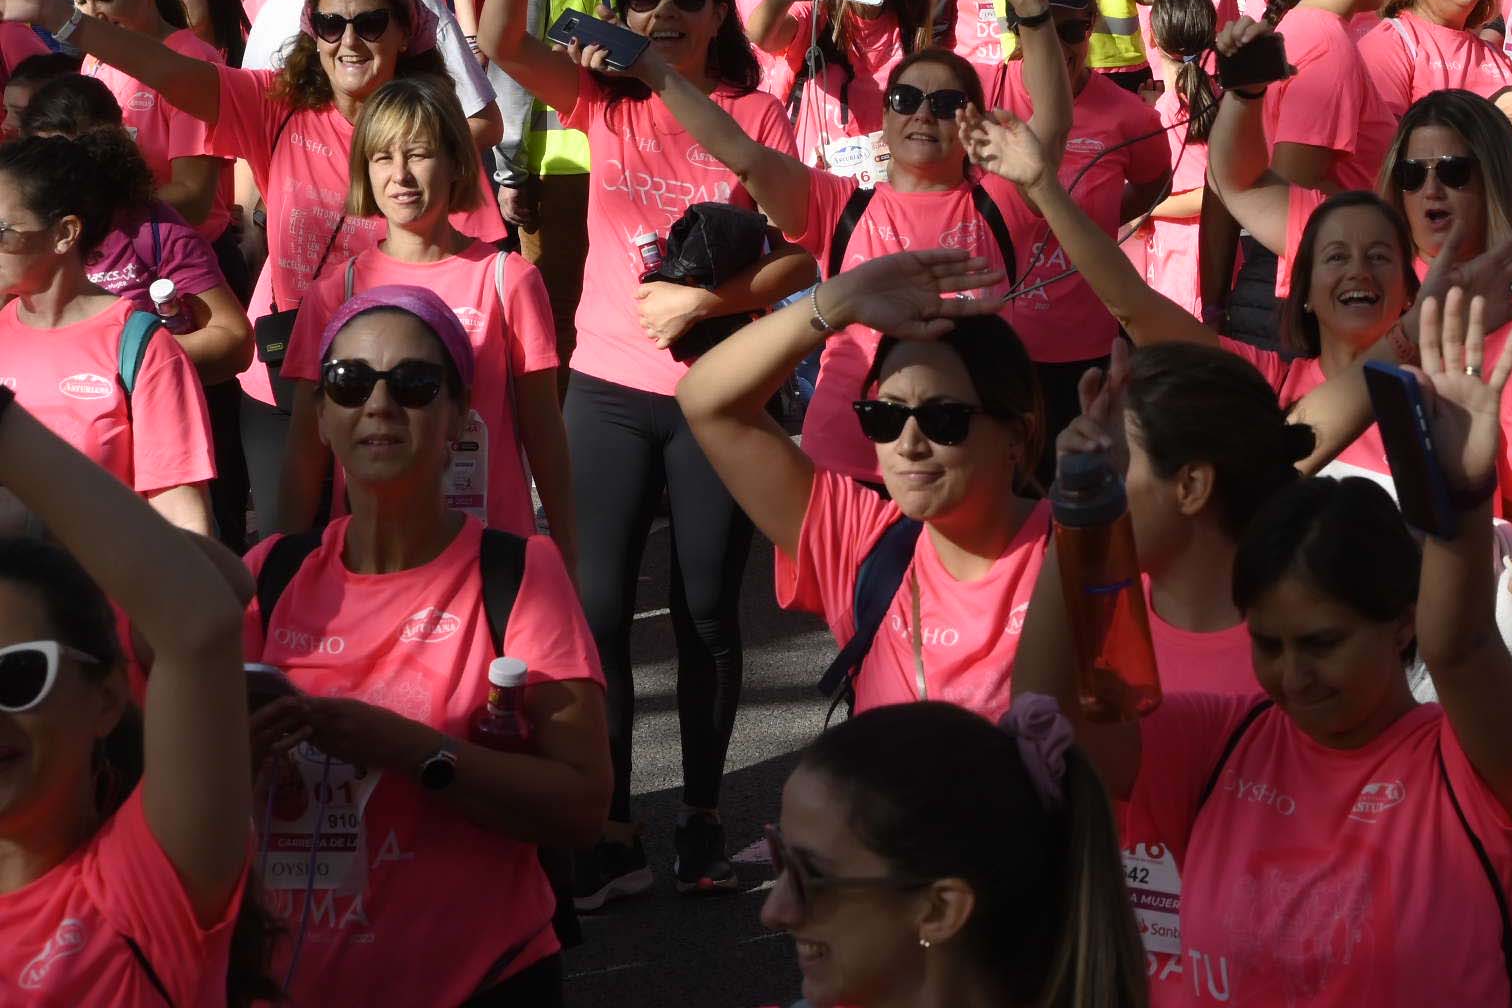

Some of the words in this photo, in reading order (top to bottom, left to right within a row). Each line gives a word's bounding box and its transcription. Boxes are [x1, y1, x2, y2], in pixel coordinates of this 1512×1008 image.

[275, 627, 344, 655] OYSHO
[272, 862, 329, 877] OYSO
[1125, 865, 1150, 884] 42
[1140, 893, 1180, 909] MUJER
[1190, 949, 1229, 1001] TU
